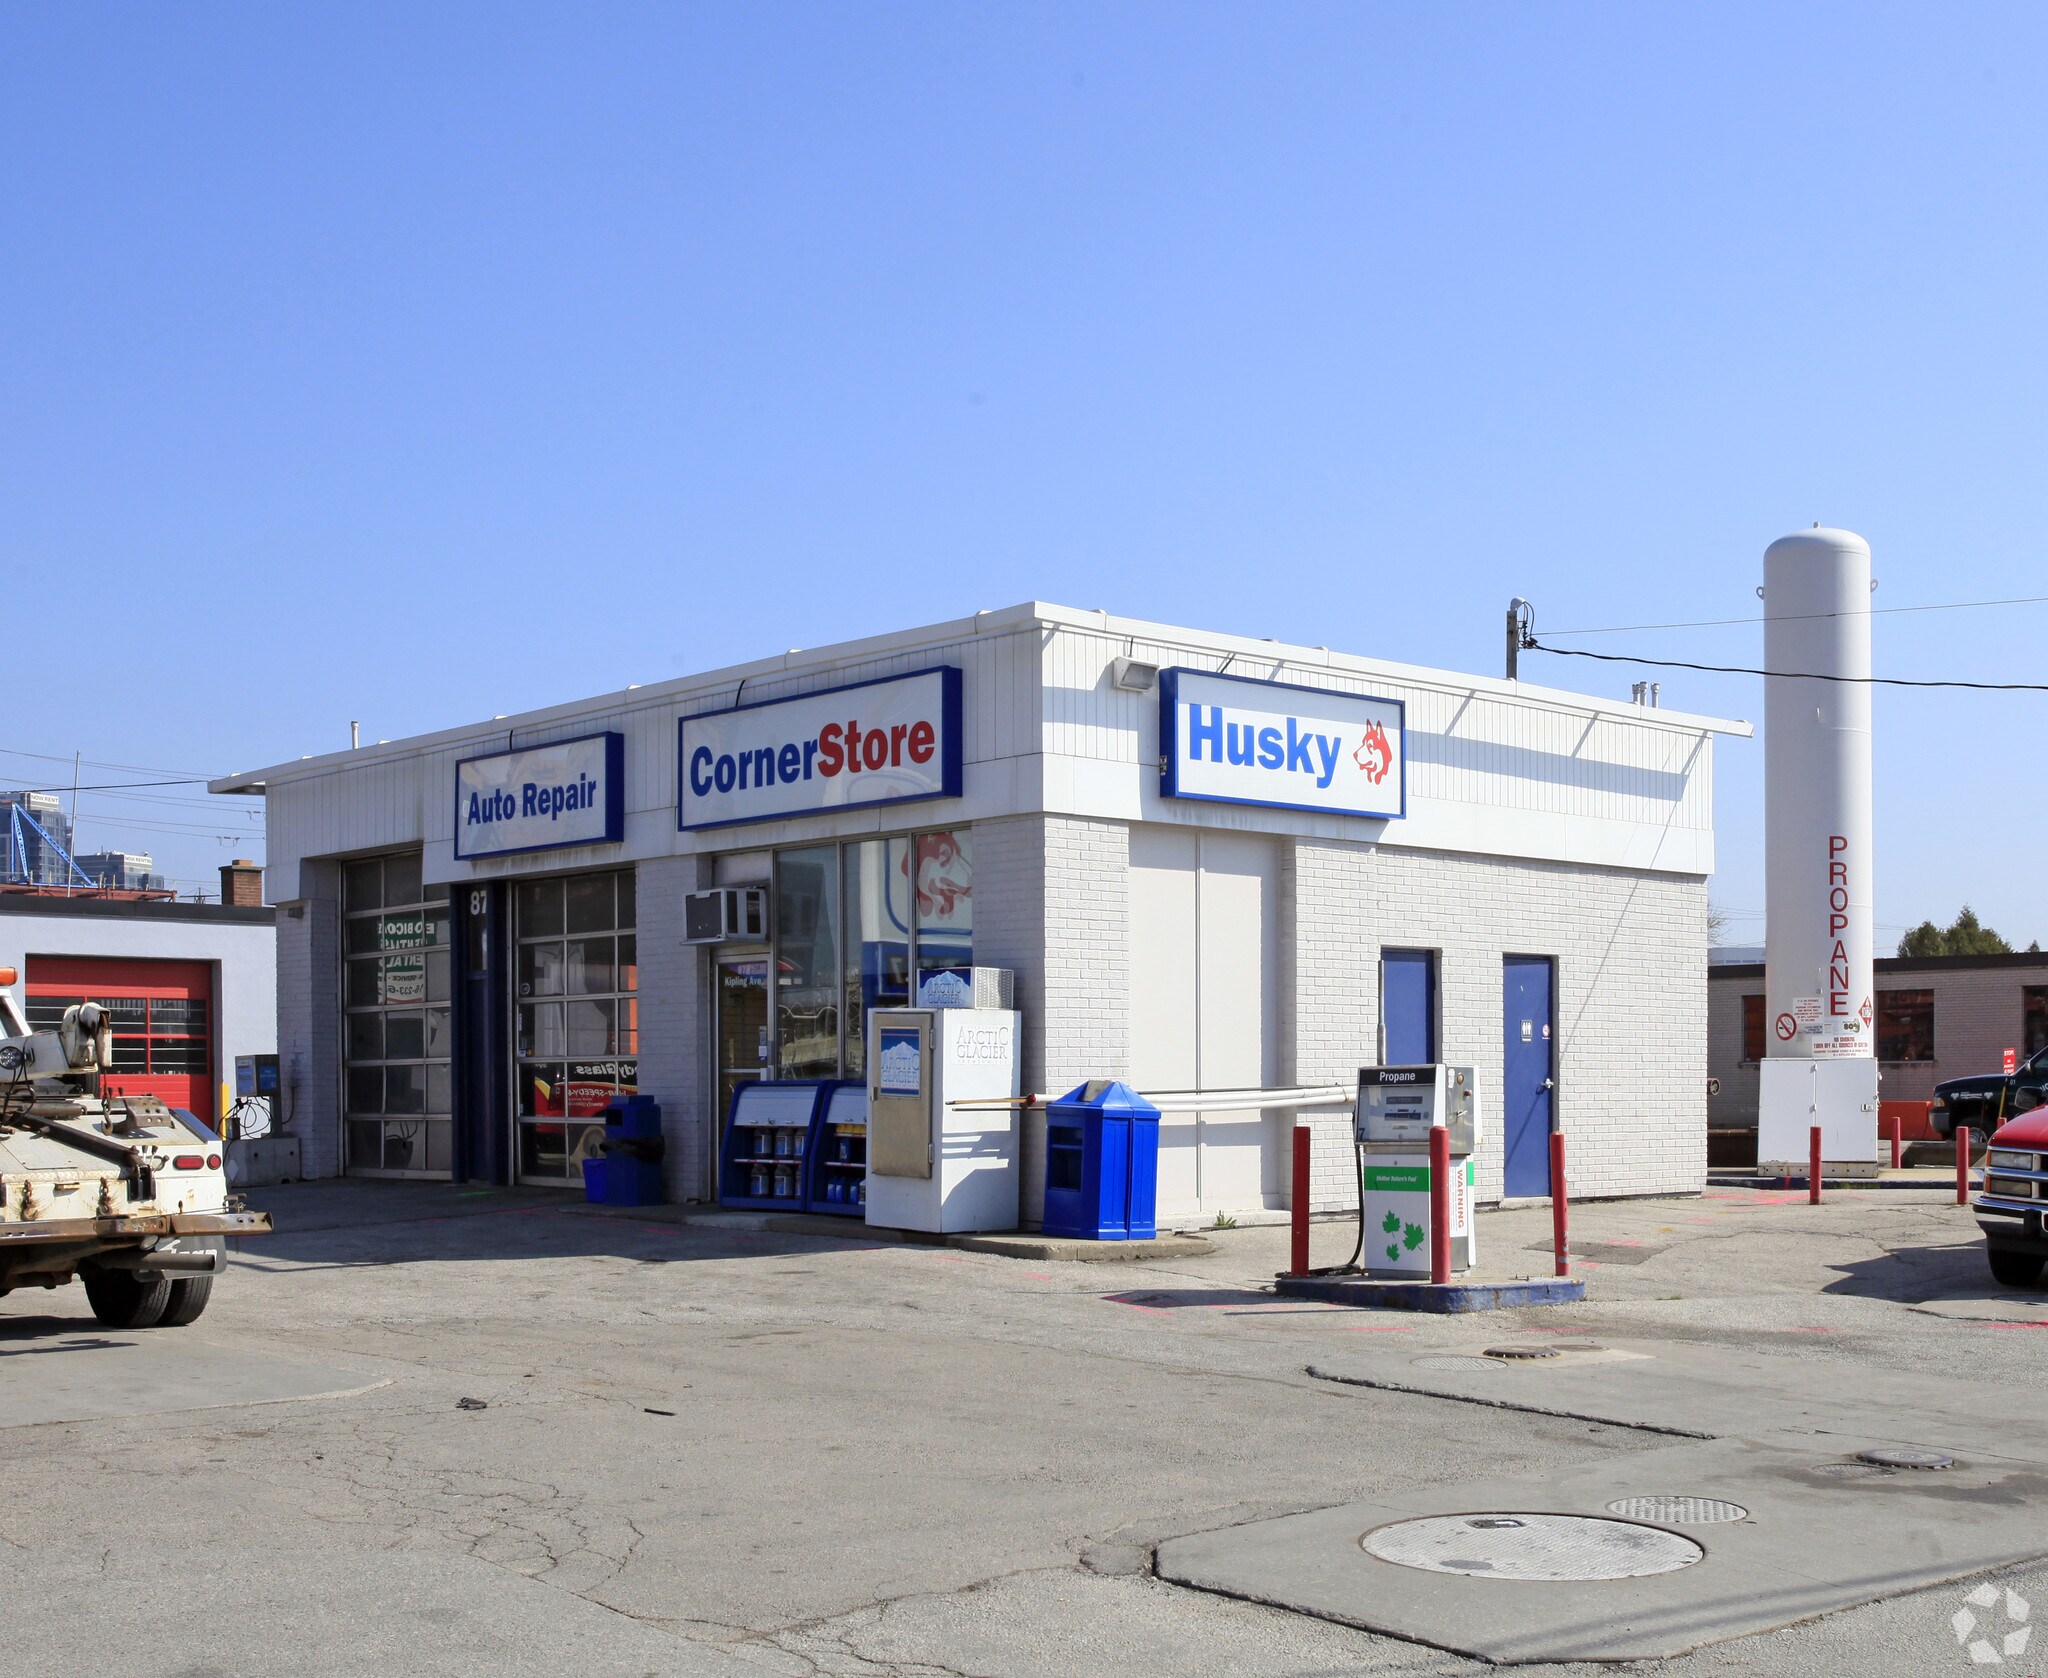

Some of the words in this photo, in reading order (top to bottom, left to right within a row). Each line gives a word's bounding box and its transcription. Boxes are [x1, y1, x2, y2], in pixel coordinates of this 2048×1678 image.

[1189, 703, 1342, 789] Husky
[690, 720, 935, 797] CornerStore
[467, 788, 515, 826] Auto
[522, 772, 597, 821] Repair
[1828, 835, 1849, 1016] PROPANE
[724, 976, 748, 988] Kipling
[927, 979, 962, 994] ARCTIC
[928, 993, 960, 1004] GLACIER
[956, 1025, 1009, 1046] ARCTIC
[881, 1053, 920, 1071] ARCTIC
[957, 1045, 1008, 1060] GLACIER
[1380, 1071, 1416, 1083] Propane
[1457, 1169, 1465, 1229] WARNING
